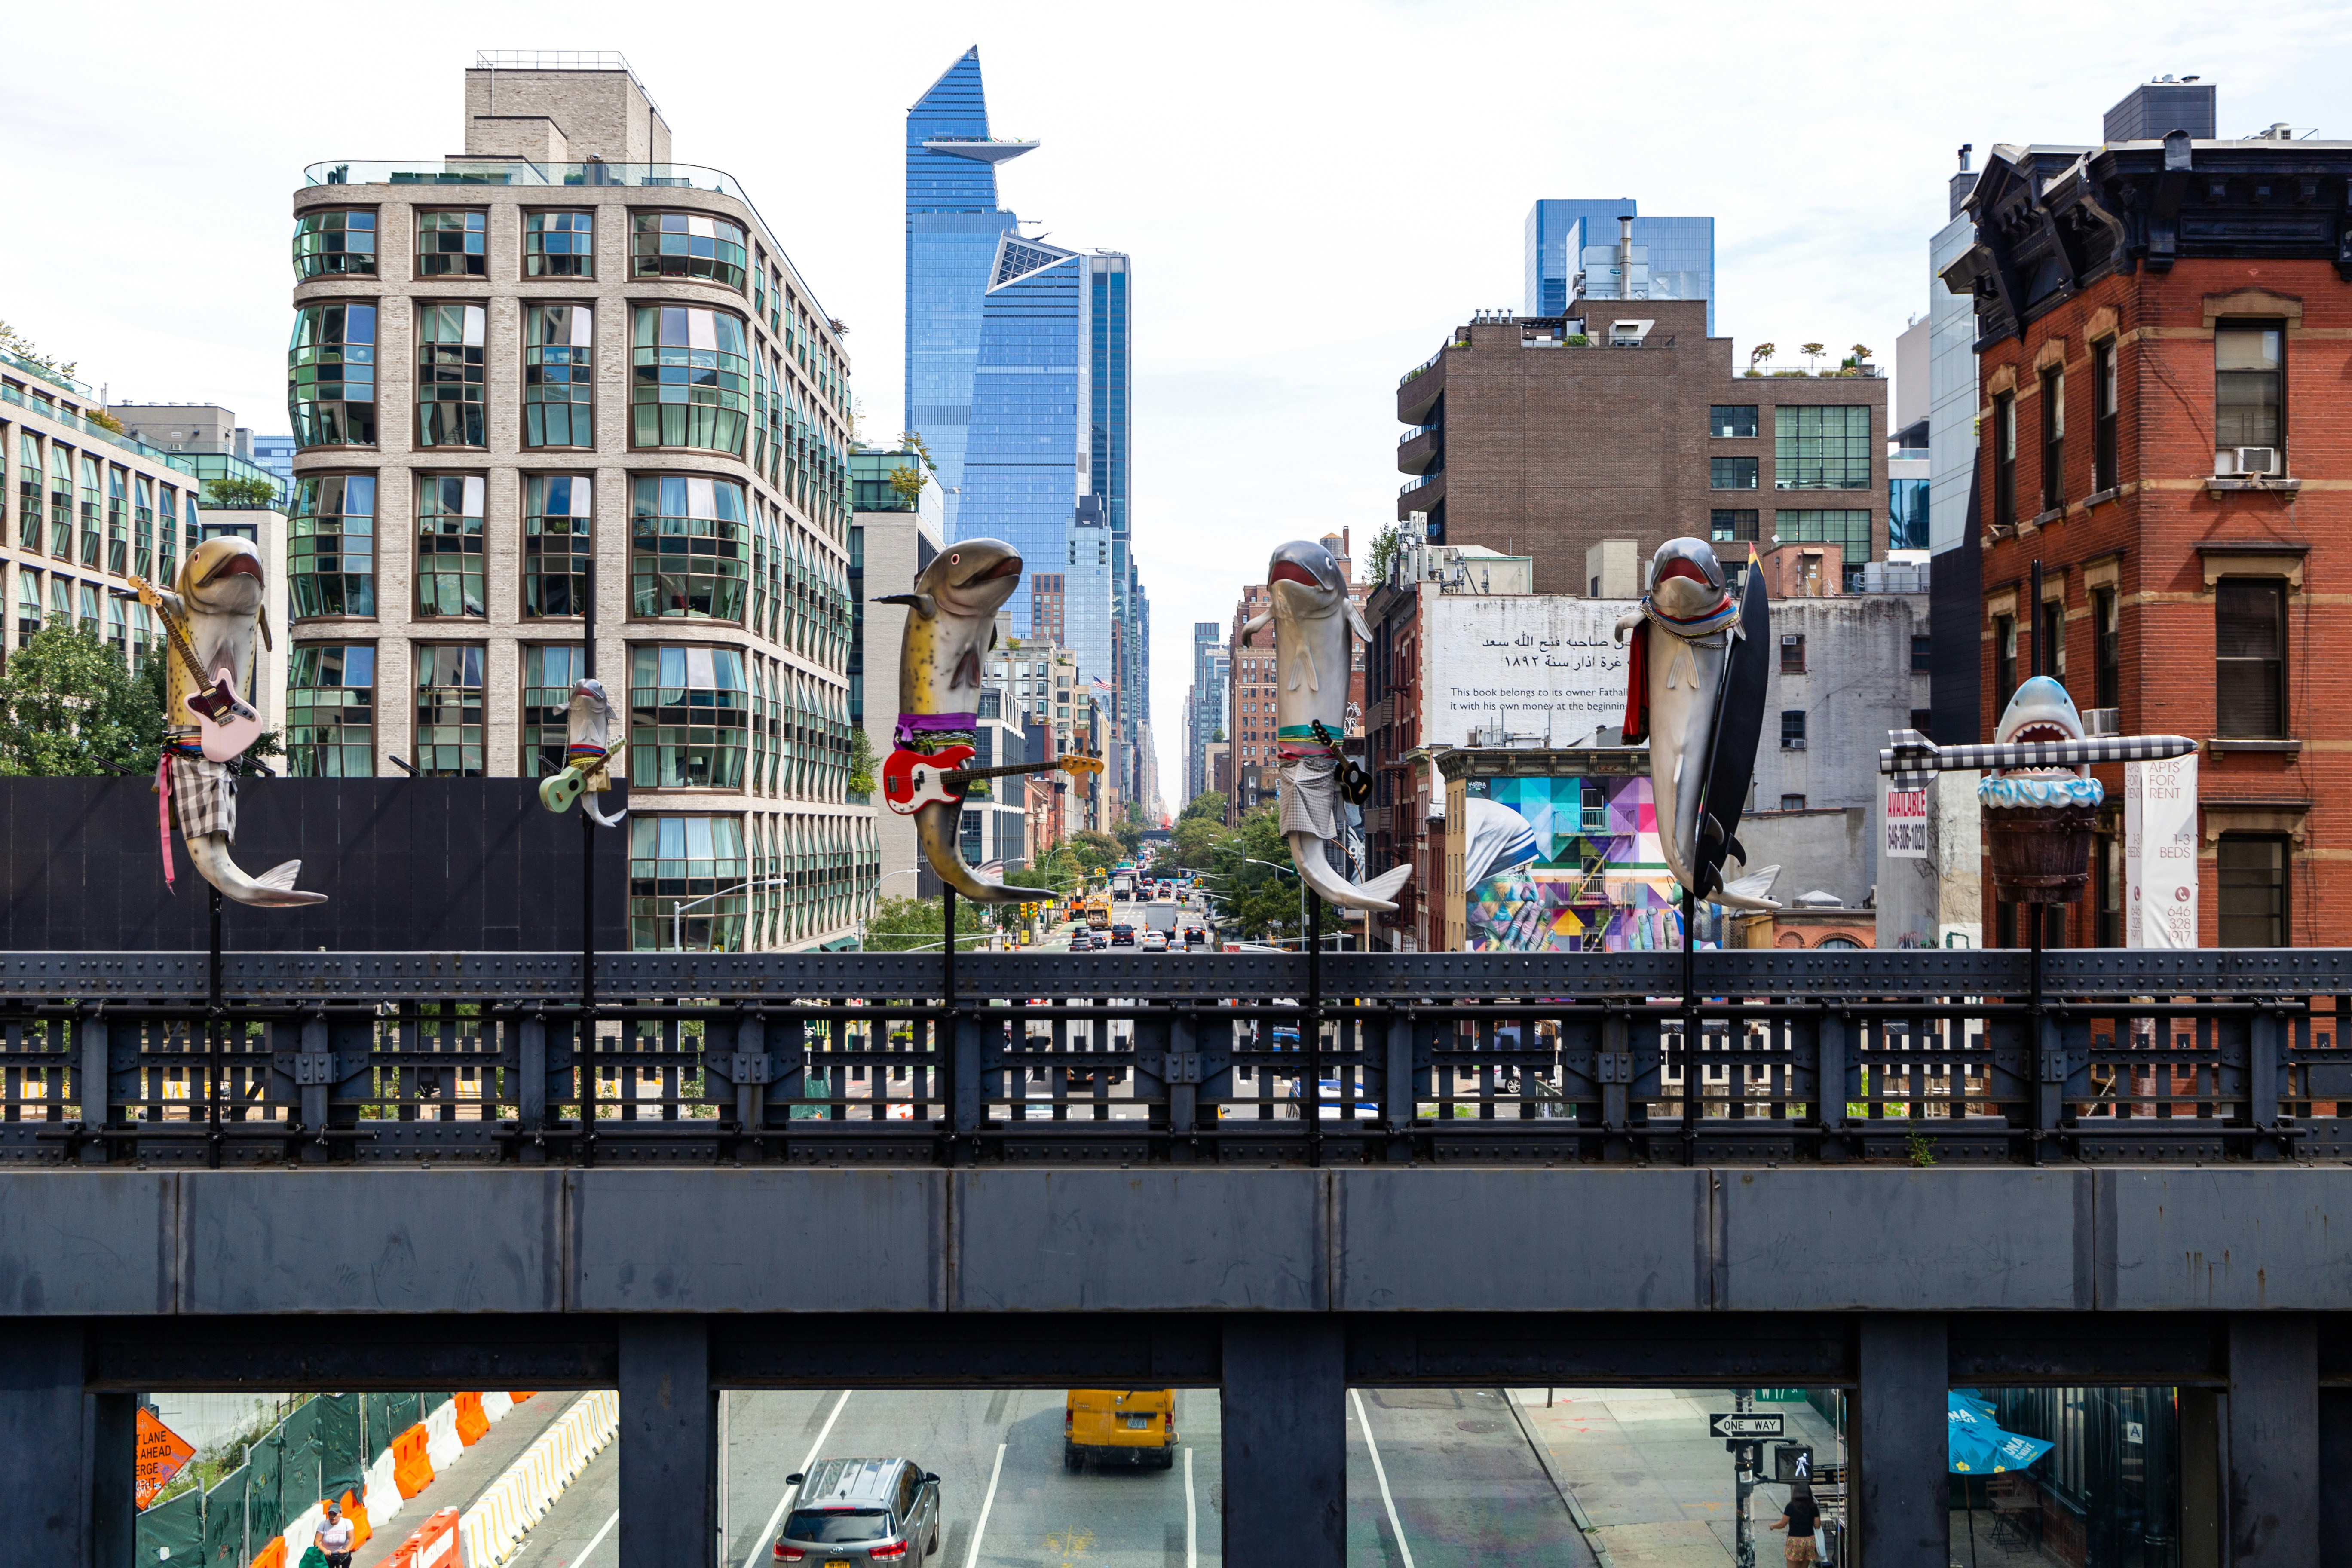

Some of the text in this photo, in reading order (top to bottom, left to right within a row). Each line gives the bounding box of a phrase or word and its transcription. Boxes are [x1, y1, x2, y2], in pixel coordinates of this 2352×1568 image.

[1540, 636, 1560, 652] فتح
[1566, 636, 1608, 650] صاحبه
[1505, 655, 1621, 671] غرة اذار سنة ١٨٩٢
[1451, 688, 1470, 696] This
[1473, 688, 1497, 696] book
[1501, 688, 1534, 698] belongs
[1599, 688, 1629, 696] Fathall
[2128, 762, 2139, 772] APTS
[2149, 762, 2180, 773] APTS
[2128, 775, 2138, 786] FOR
[2150, 775, 2175, 786] FOR
[2128, 787, 2139, 798] RENT
[2150, 787, 2181, 798] RENT
[1888, 790, 1926, 817] AVAILABLE
[1888, 824, 1925, 850] 646-306-1020
[2174, 834, 2190, 845] 1-3
[2128, 846, 2141, 858] BEDS
[2160, 847, 2190, 858] BEDS
[2168, 906, 2191, 916] 646
[2169, 918, 2191, 929] 328
[2167, 931, 2190, 942] 1917
[1724, 1421, 1776, 1430] ONE WAY
[2131, 1425, 2140, 1438] A
[143, 1431, 166, 1445] LANE
[2002, 1437, 2025, 1456] ONA
[141, 1445, 171, 1460] AHEAD
[136, 1462, 158, 1476] ERGE
